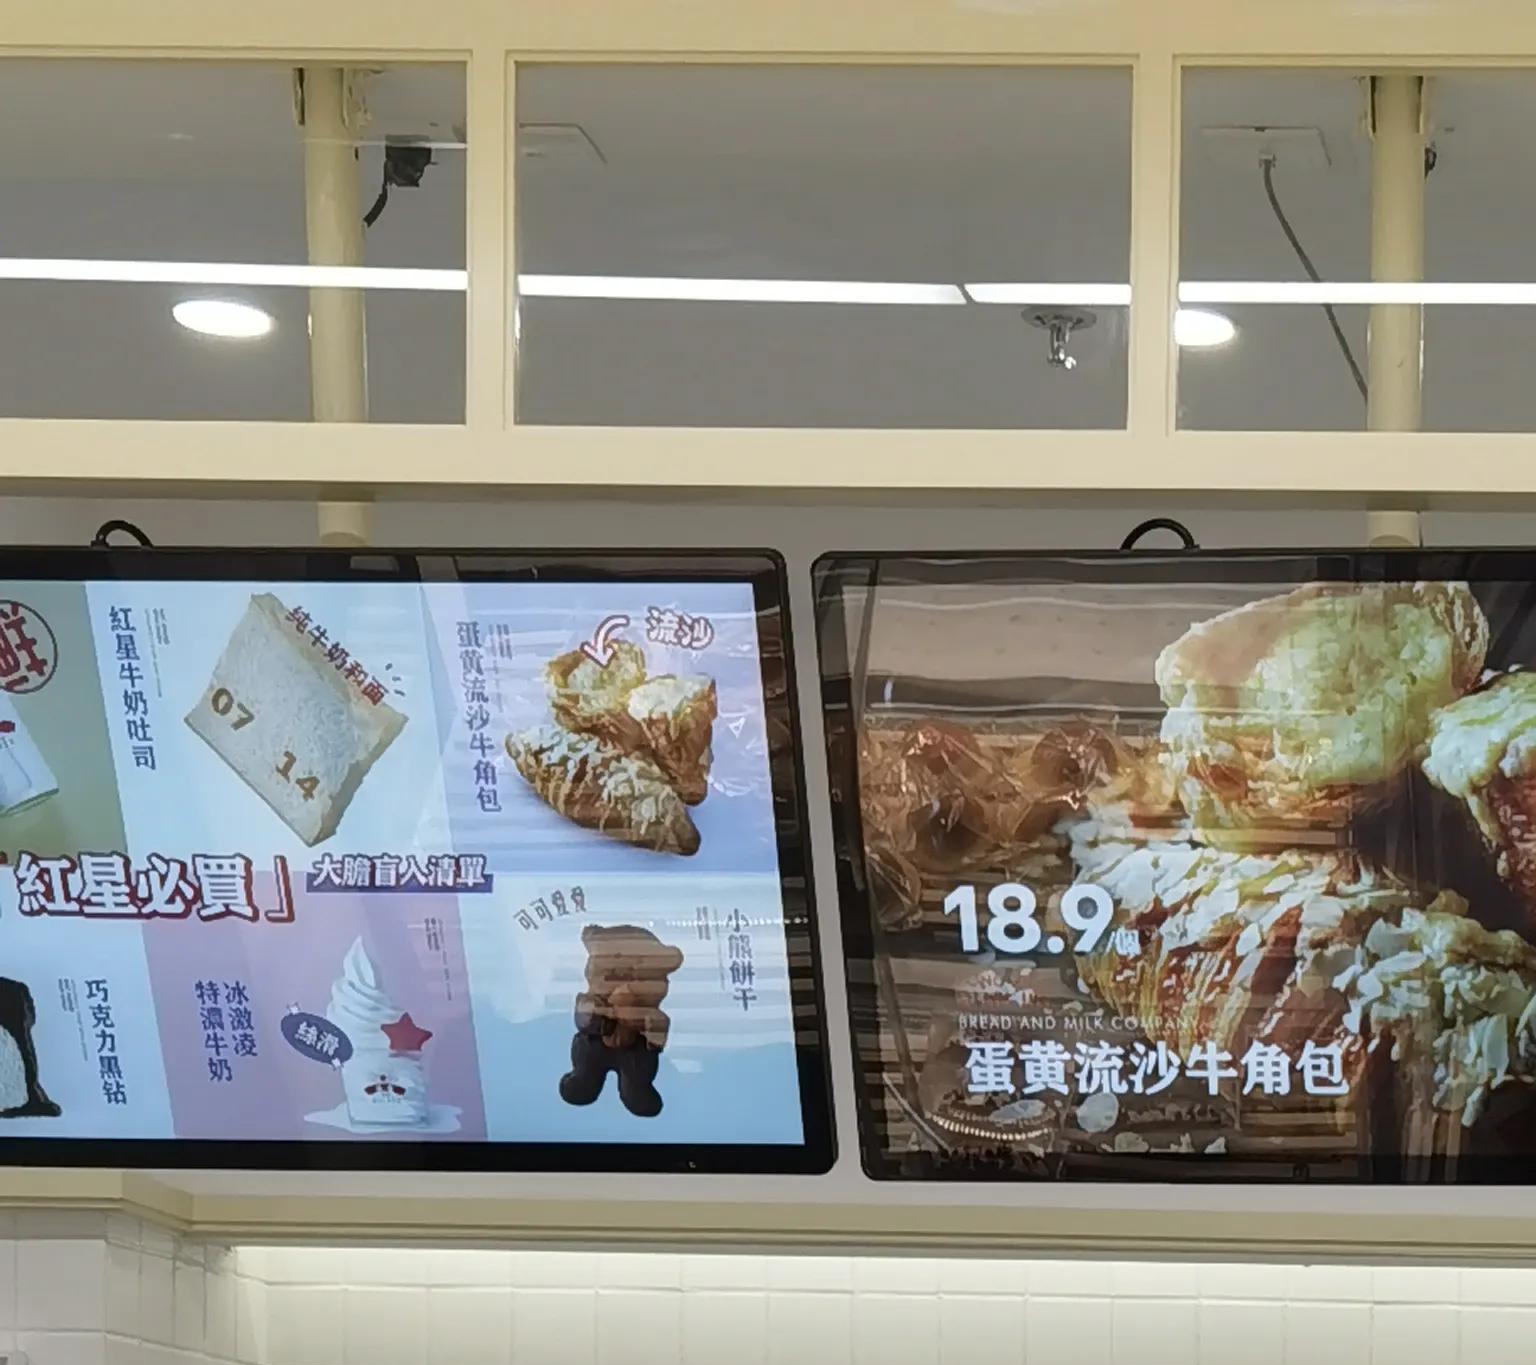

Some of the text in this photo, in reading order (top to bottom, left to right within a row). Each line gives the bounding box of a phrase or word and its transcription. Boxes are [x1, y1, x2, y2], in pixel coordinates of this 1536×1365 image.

[646, 606, 714, 649] 流沙
[958, 1013, 1012, 1031] BREAD
[1018, 1015, 1057, 1031] AND
[1063, 1015, 1103, 1032] MILK
[964, 1039, 1351, 1097] 蛋黄流沙牛角包
